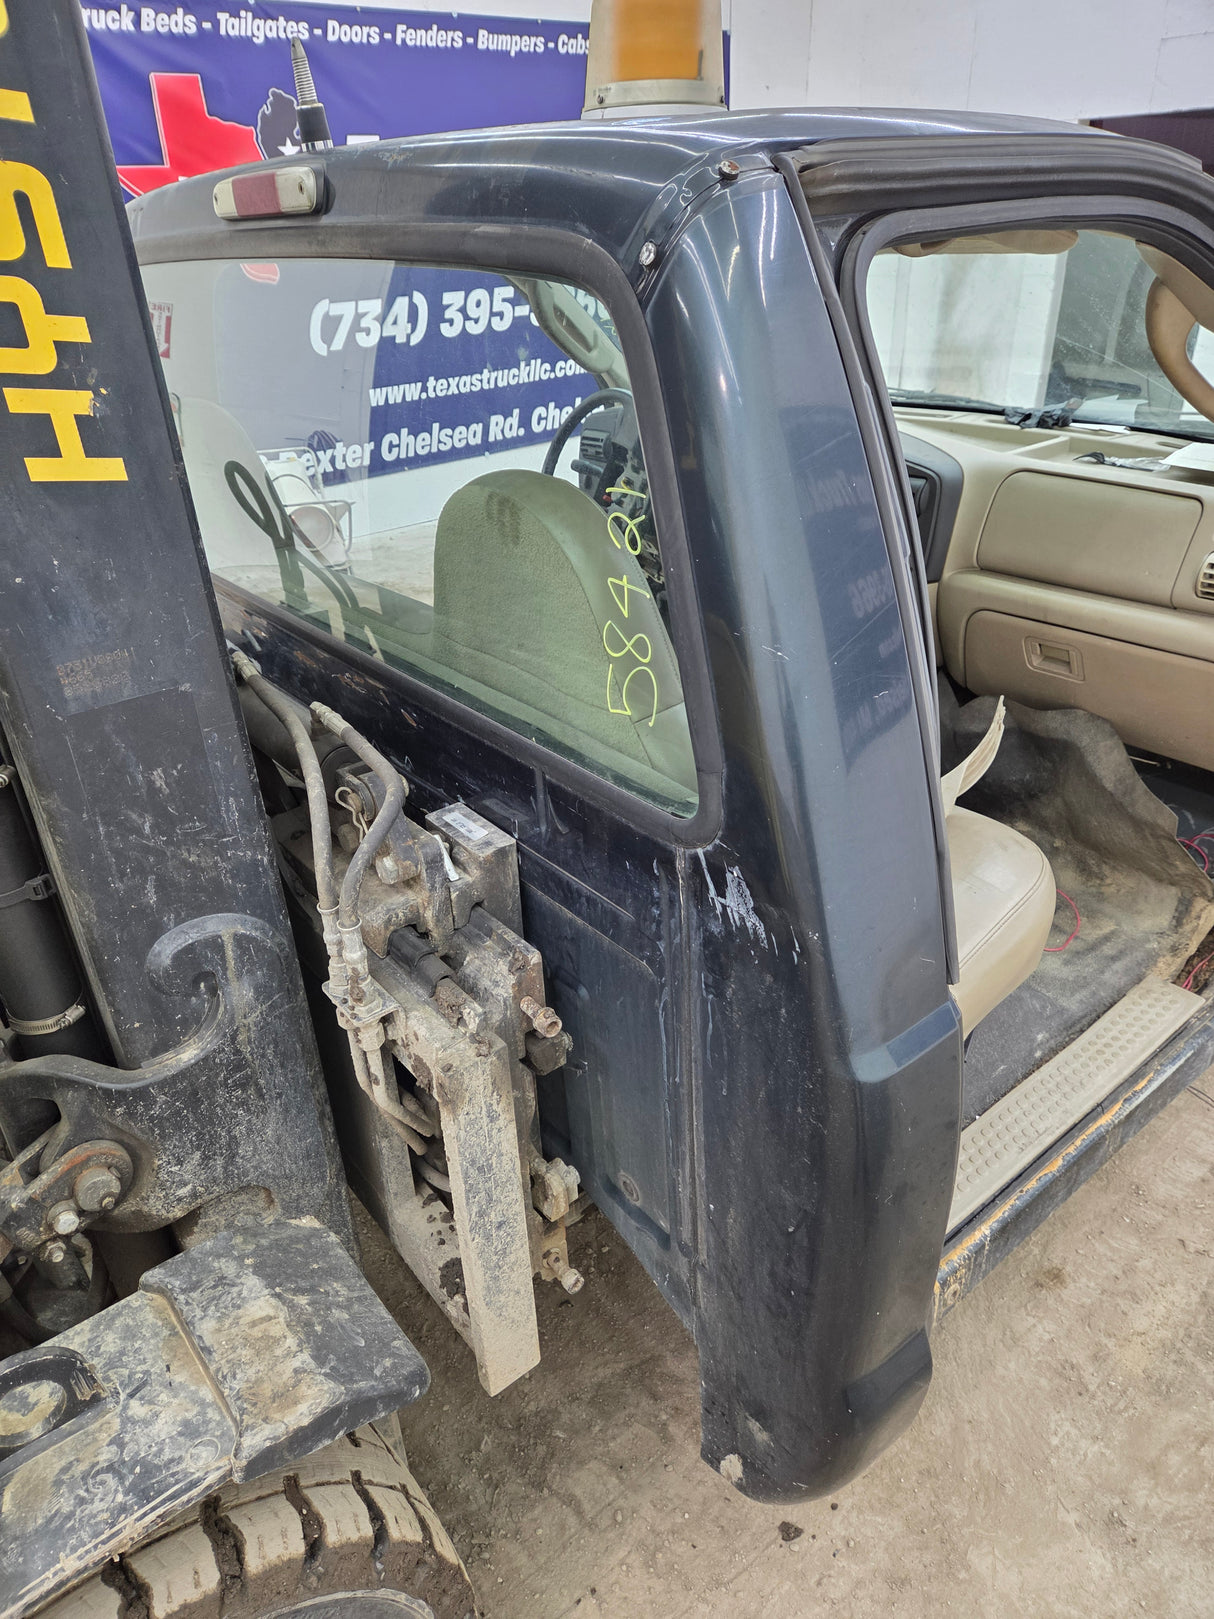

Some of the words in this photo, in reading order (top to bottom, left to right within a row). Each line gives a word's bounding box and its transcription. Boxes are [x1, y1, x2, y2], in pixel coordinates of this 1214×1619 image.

[81, 4, 136, 32] ruck
[140, 7, 198, 34] Beds
[216, 10, 310, 44] Tailgates
[326, 19, 380, 45] Doors
[396, 23, 463, 48] Fenders
[477, 29, 545, 57] Bumpers
[309, 290, 429, 357] (734)
[279, 441, 375, 477] exter
[381, 422, 484, 461] Chelsea
[488, 408, 526, 443] Rd.
